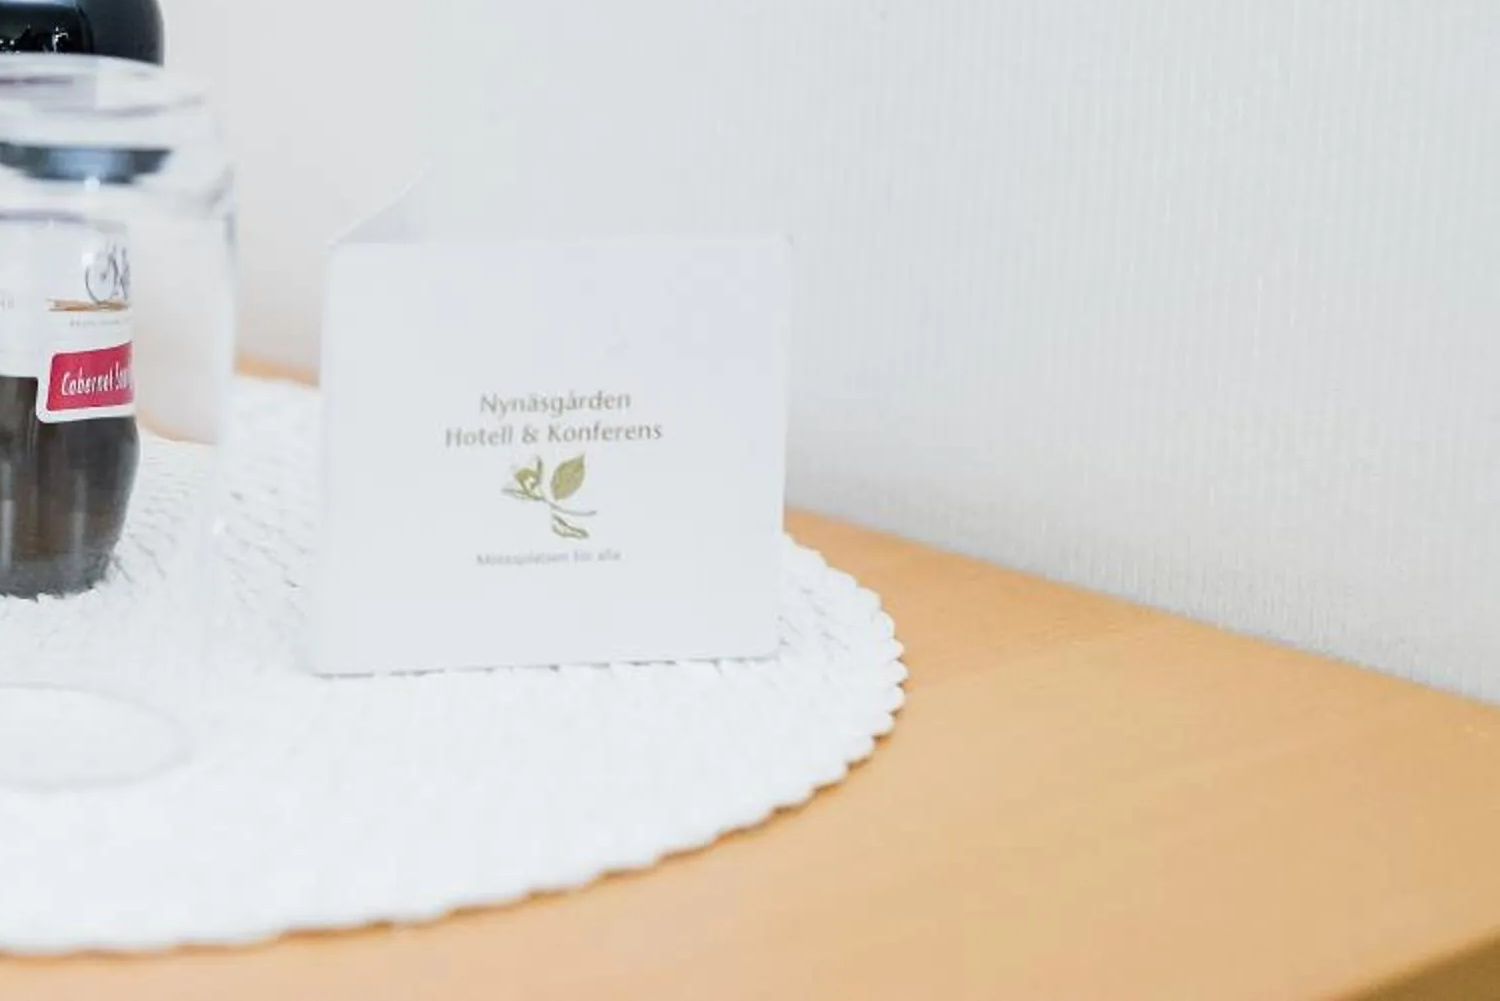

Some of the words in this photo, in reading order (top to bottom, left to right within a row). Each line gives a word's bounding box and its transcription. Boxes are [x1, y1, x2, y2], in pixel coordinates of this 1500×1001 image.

[61, 365, 113, 396] Cabernet
[479, 389, 631, 420] Nynäsgården
[445, 425, 513, 448] Hotell
[521, 426, 539, 444] &
[547, 421, 663, 443] Konferens
